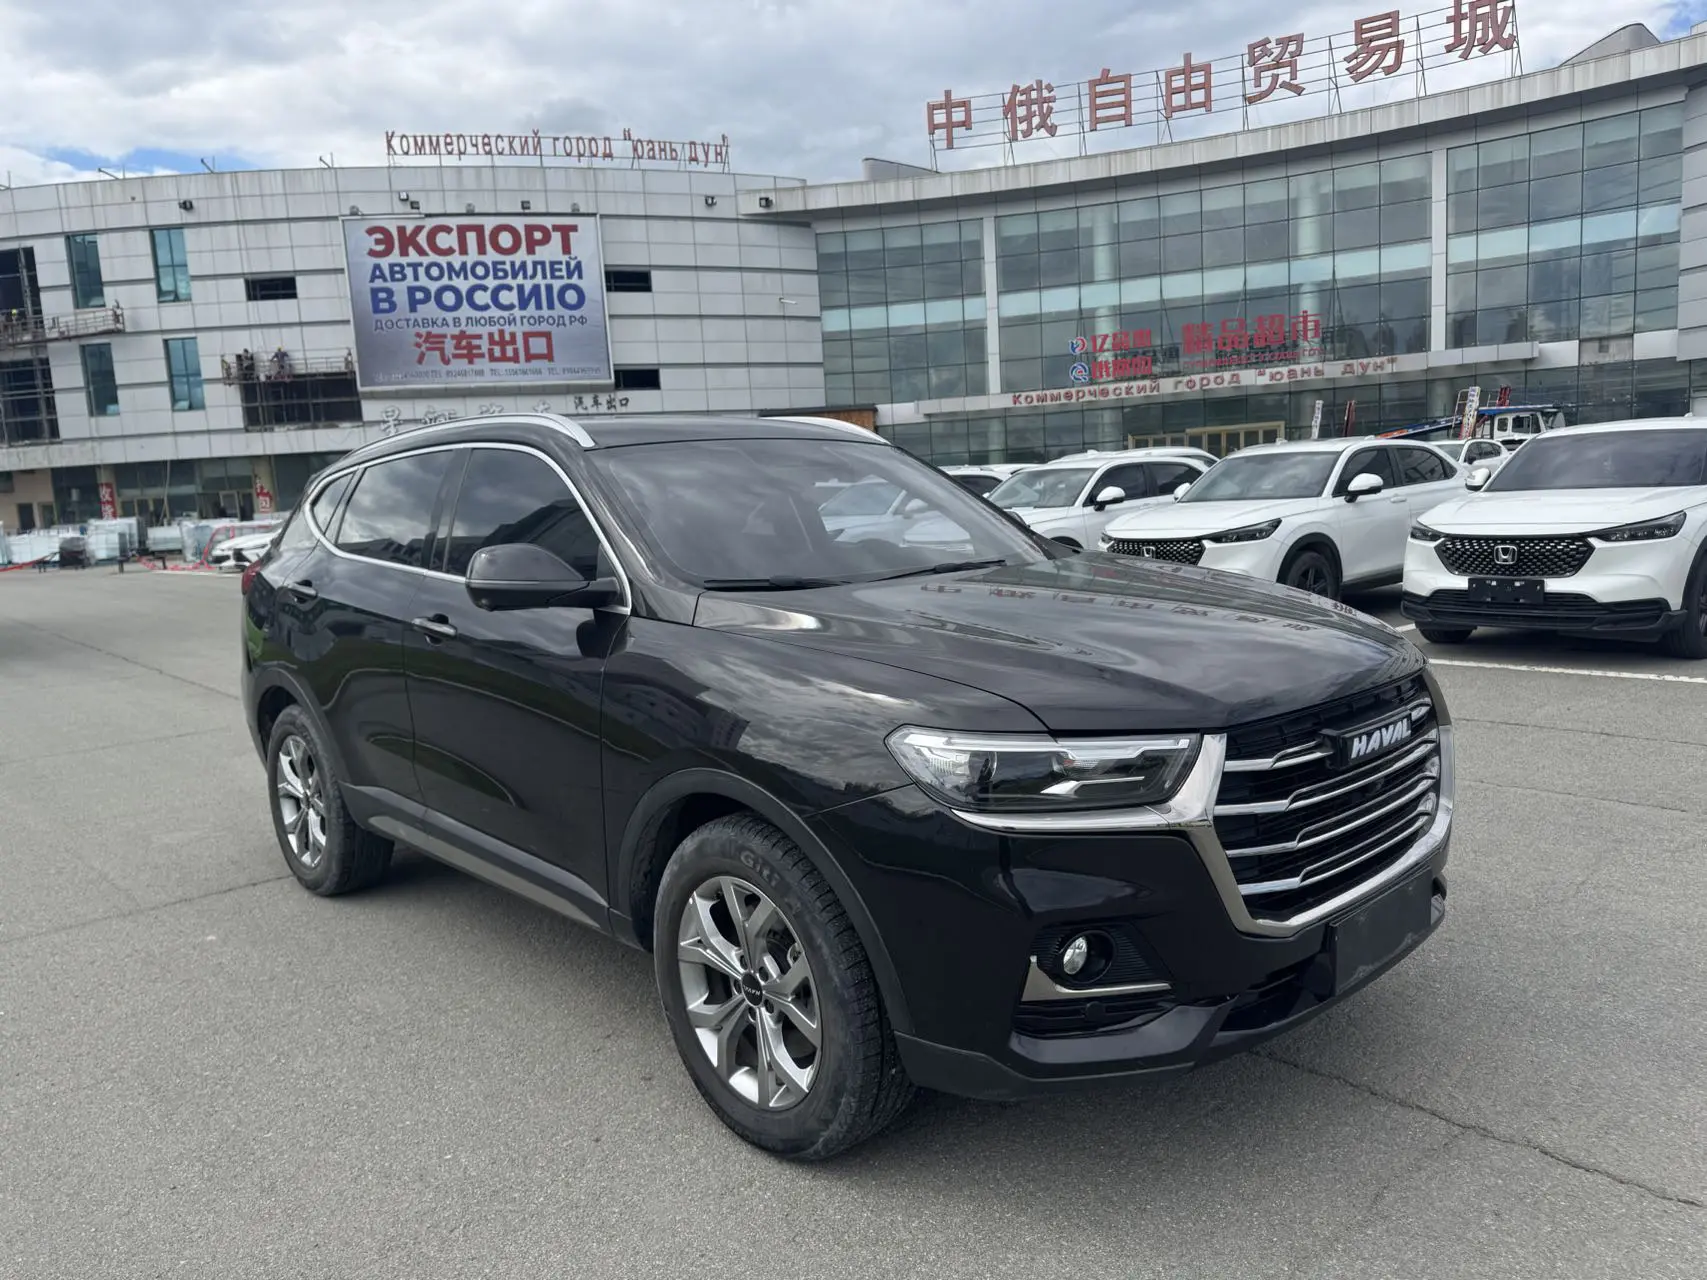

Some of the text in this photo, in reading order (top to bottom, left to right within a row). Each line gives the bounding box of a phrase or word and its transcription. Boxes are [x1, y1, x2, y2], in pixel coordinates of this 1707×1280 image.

[927, 0, 1516, 149] 中俄自由贸易城
[386, 129, 541, 161] Коммерческий
[552, 136, 614, 162] город
[365, 224, 579, 258] ЭКСПОРТ
[369, 256, 584, 284] АВТОМОБИЛЕЙ
[370, 283, 586, 314] В РОССИЮ
[374, 313, 588, 331] ДОСТАВКА В ЛЮБОЙ ГОРОД РФ
[414, 328, 556, 366] 汽车出口
[573, 393, 630, 412] 汽车出口
[1012, 379, 1160, 405] Коммерческий
[1174, 372, 1241, 392] город
[1351, 718, 1412, 759] HAVAL
